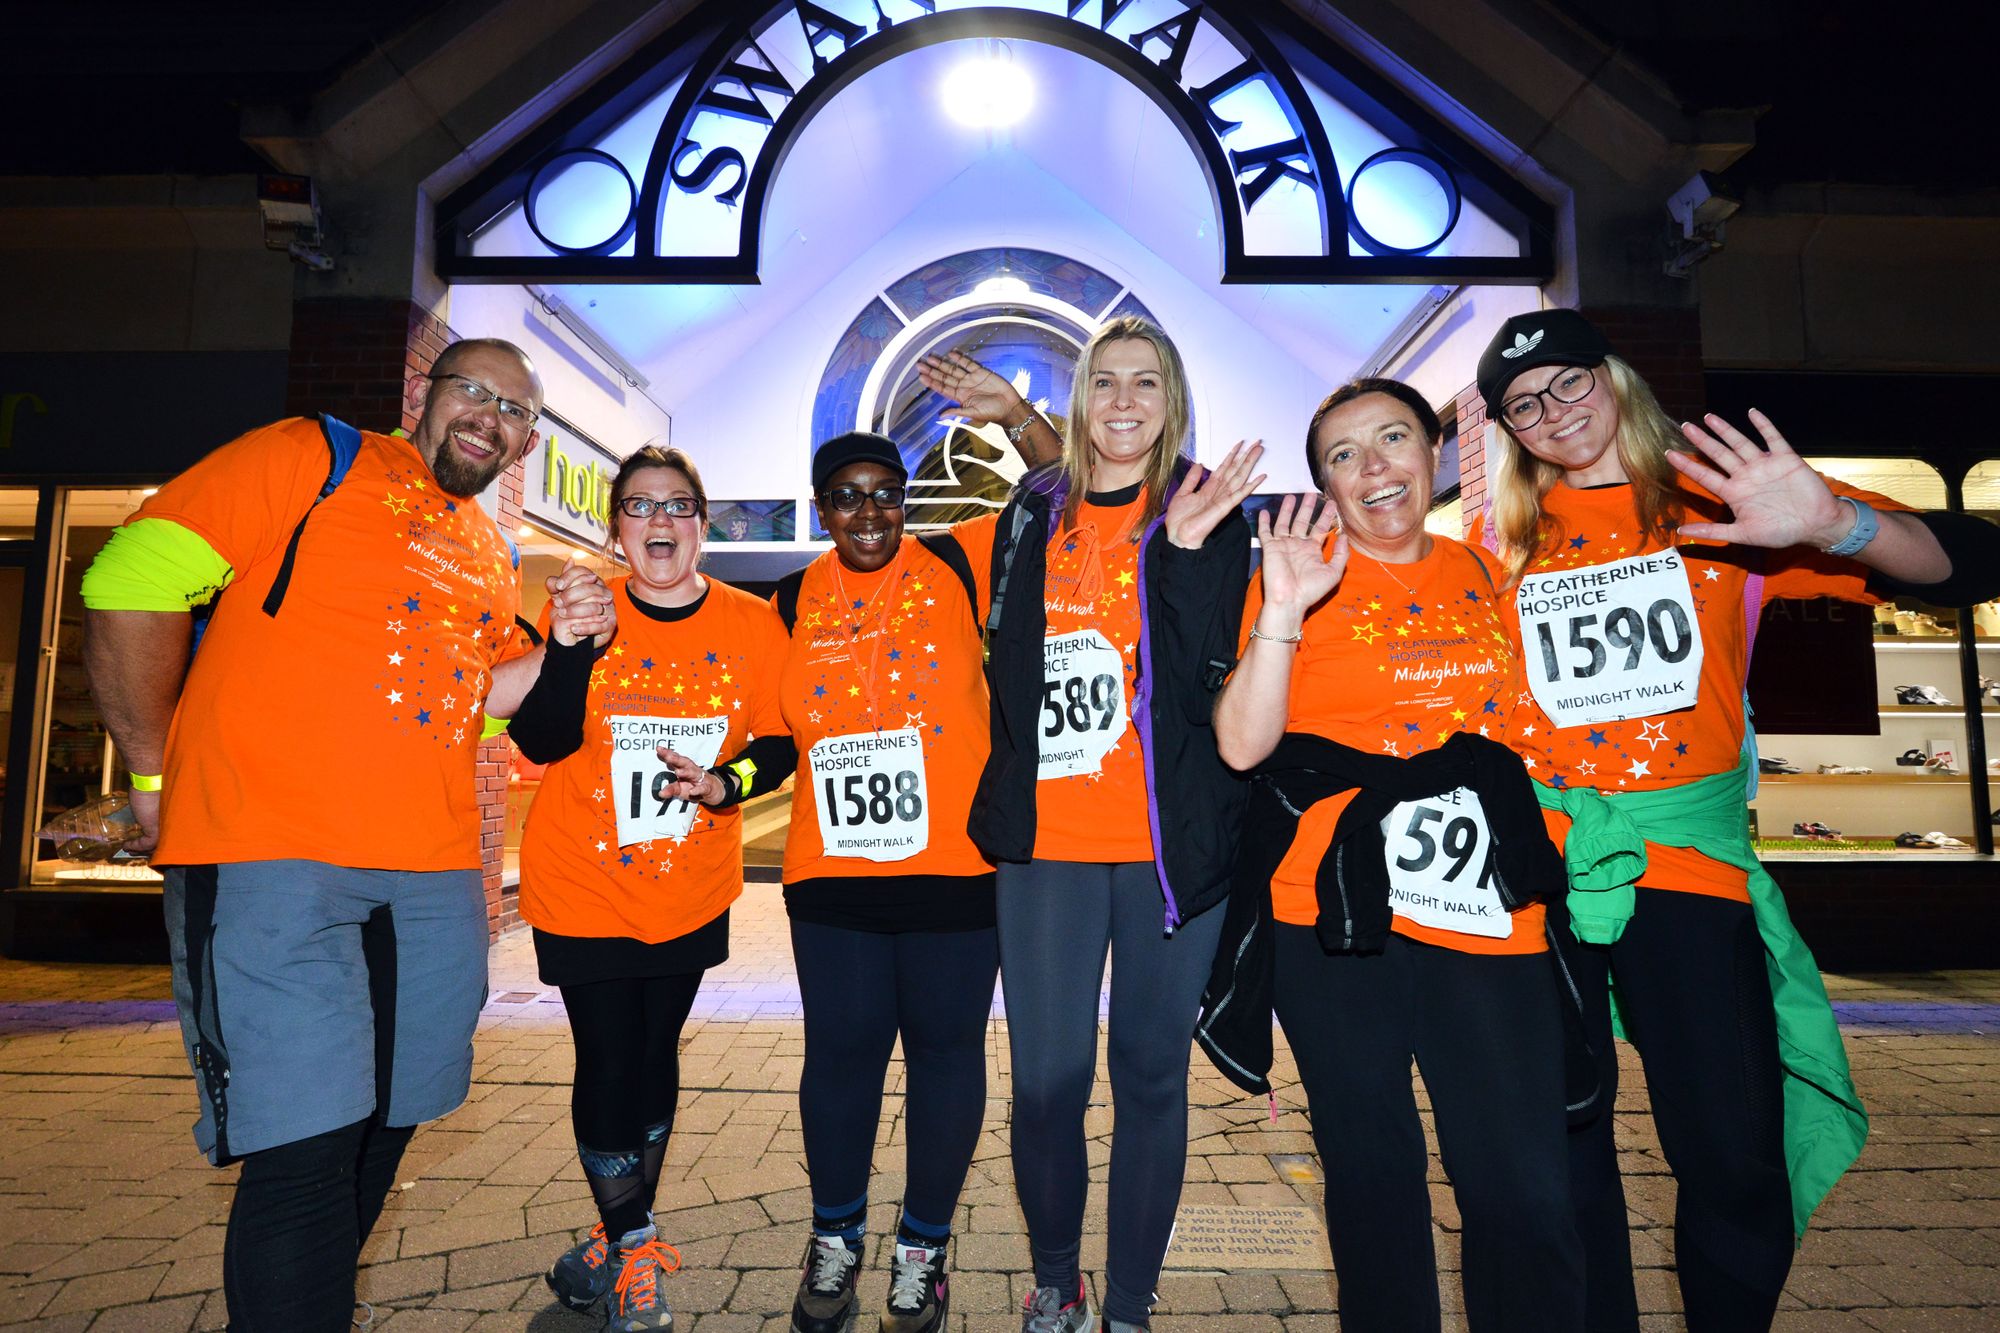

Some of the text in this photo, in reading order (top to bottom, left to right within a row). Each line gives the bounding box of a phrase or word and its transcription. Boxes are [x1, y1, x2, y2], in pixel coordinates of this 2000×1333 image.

[407, 541, 460, 575] Midnight
[1519, 556, 1678, 598] ST CATHERINE'S
[1521, 589, 1607, 616] HOSPICE
[1536, 598, 1692, 682] 1590
[1389, 649, 1443, 662] HOSPICE
[1394, 660, 1461, 688] Midnight
[1556, 680, 1685, 710] MIDNIGHT WALK
[603, 702, 648, 712] HOSPICE
[628, 722, 726, 737] CATHERINE'S
[811, 734, 918, 758] ST CATHERINE'S
[814, 755, 871, 771] HOSPICE
[1039, 749, 1084, 763] MIDNIGHT
[825, 770, 922, 827] 1588
[837, 836, 914, 849] MIDNIGHT WALK
[1443, 900, 1488, 917] WALK
[1225, 1208, 1304, 1217] shopping
[1230, 1217, 1268, 1225] built
[1267, 1227, 1320, 1235] where
[1177, 1235, 1224, 1243] Swan
[1263, 1236, 1297, 1244] had
[1228, 1246, 1299, 1255] stables.
